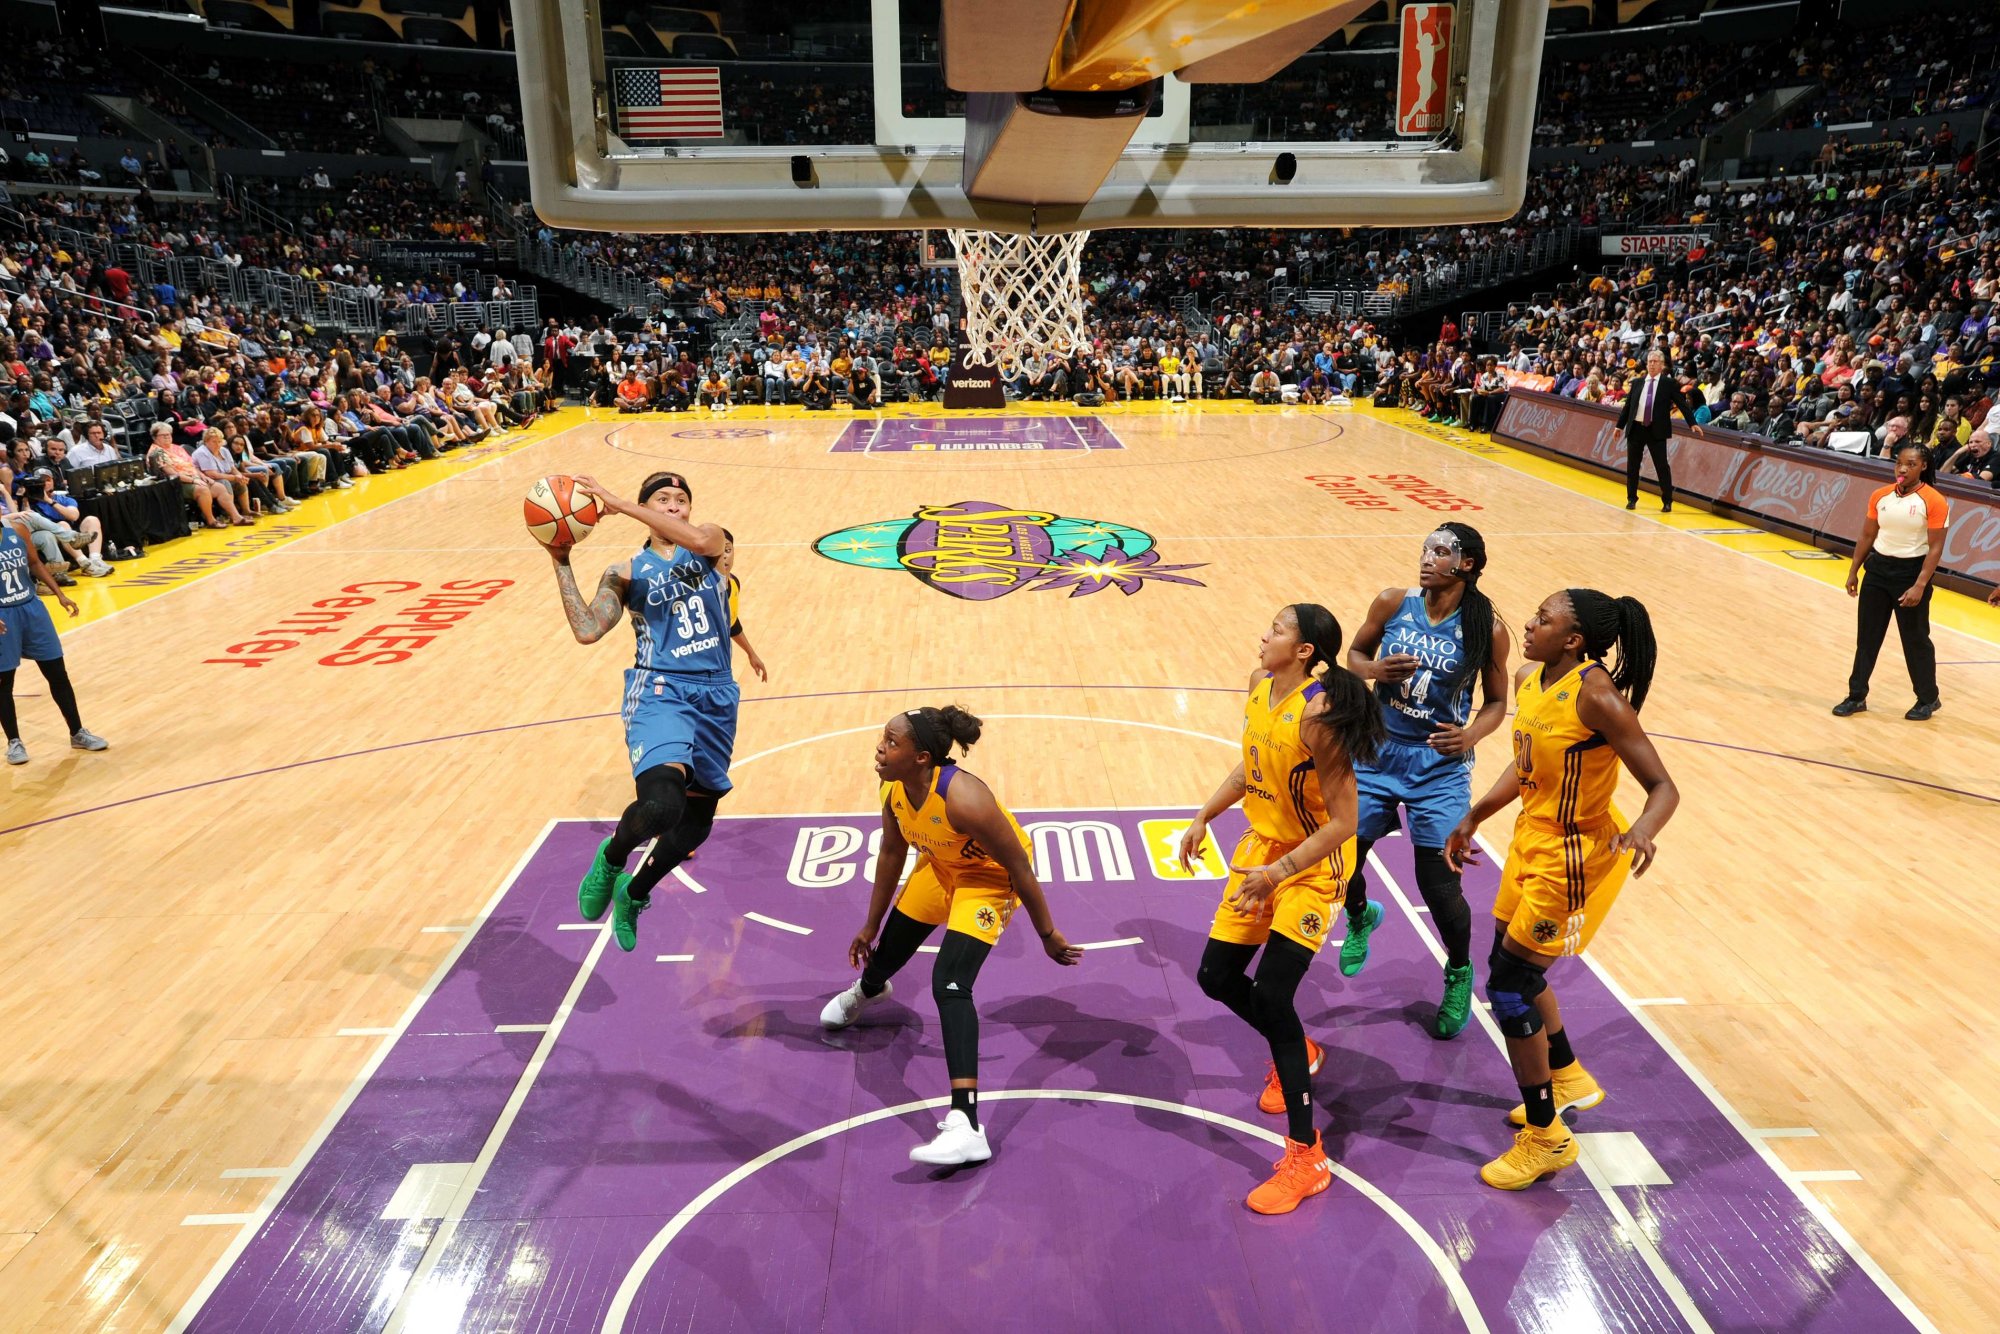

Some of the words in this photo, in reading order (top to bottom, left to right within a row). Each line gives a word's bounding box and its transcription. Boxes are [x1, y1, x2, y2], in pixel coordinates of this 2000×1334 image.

[952, 378, 991, 388] verizon
[1304, 475, 1404, 511] Center
[1367, 474, 1484, 511] STAPLES
[1734, 456, 1816, 502] Cares
[900, 504, 1057, 586] SPARKS
[1015, 524, 1029, 535] LOS
[0, 547, 22, 561] AYO
[109, 525, 318, 588] WNBA.COM
[1018, 536, 1035, 561] ANGELES
[1, 568, 23, 595] 21
[647, 559, 703, 590] MAYO
[647, 574, 713, 606] CLINIC
[201, 580, 422, 668] Center
[318, 579, 515, 667] STAPLES
[672, 595, 710, 639] 33
[671, 635, 719, 659] verizon
[1397, 627, 1457, 655] MAYO
[1390, 698, 1429, 720] verizon
[1250, 745, 1263, 783] 3
[1246, 784, 1276, 803] erzon
[902, 825, 952, 848] EquiTrust
